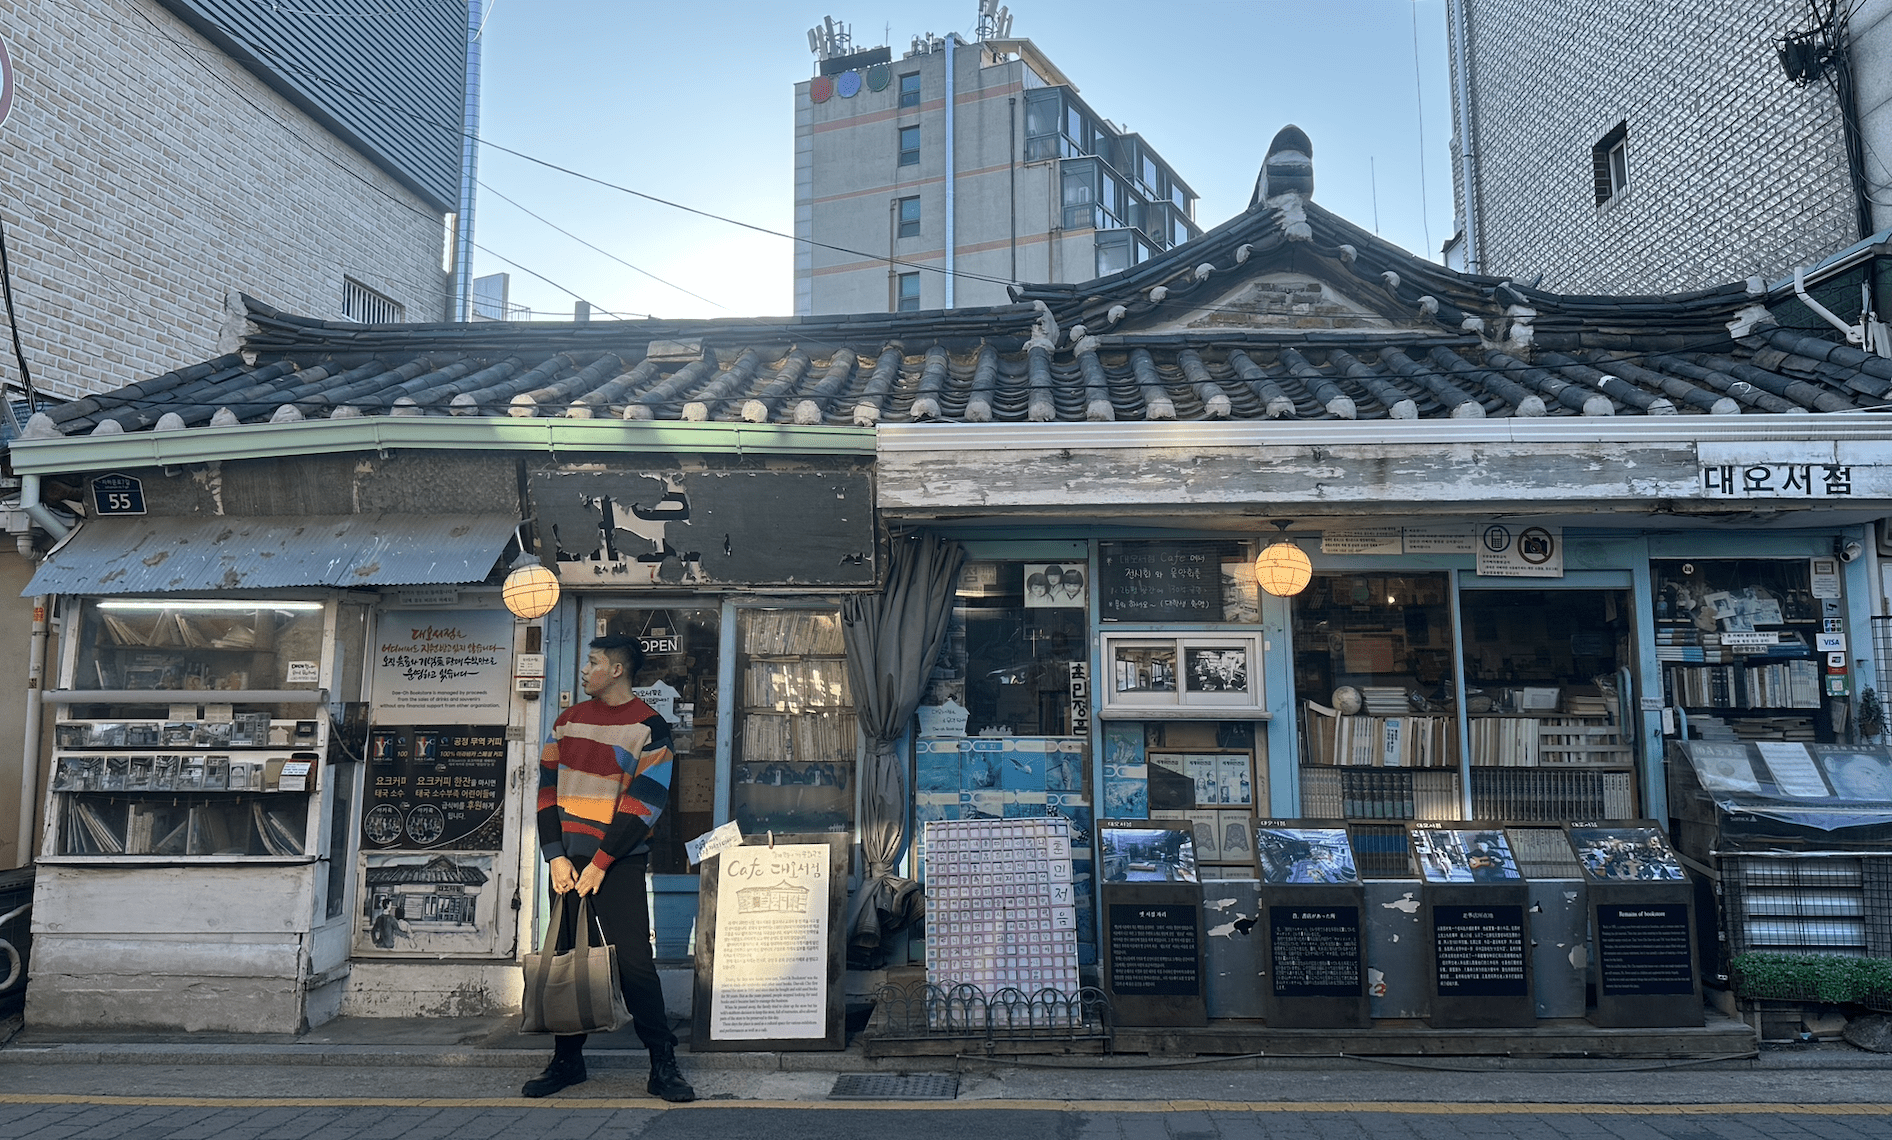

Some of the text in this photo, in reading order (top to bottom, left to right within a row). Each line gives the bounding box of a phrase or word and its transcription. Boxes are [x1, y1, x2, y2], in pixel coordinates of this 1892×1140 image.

[1704, 465, 1850, 495] 대오서점
[109, 494, 131, 509] 55
[1120, 554, 1155, 564] 대오서점
[1160, 552, 1185, 565] Cafe
[1125, 568, 1150, 579] 전시회
[641, 640, 677, 652] OPEN
[470, 737, 486, 746] 무역
[487, 738, 502, 746] 커피
[416, 777, 451, 786] 요크커피
[454, 777, 476, 787] 한잔을
[374, 789, 389, 798] 태국
[415, 789, 430, 798] 태국
[441, 801, 494, 810] 급식비를 후원하게
[728, 857, 820, 880] Cafe 대오서점
